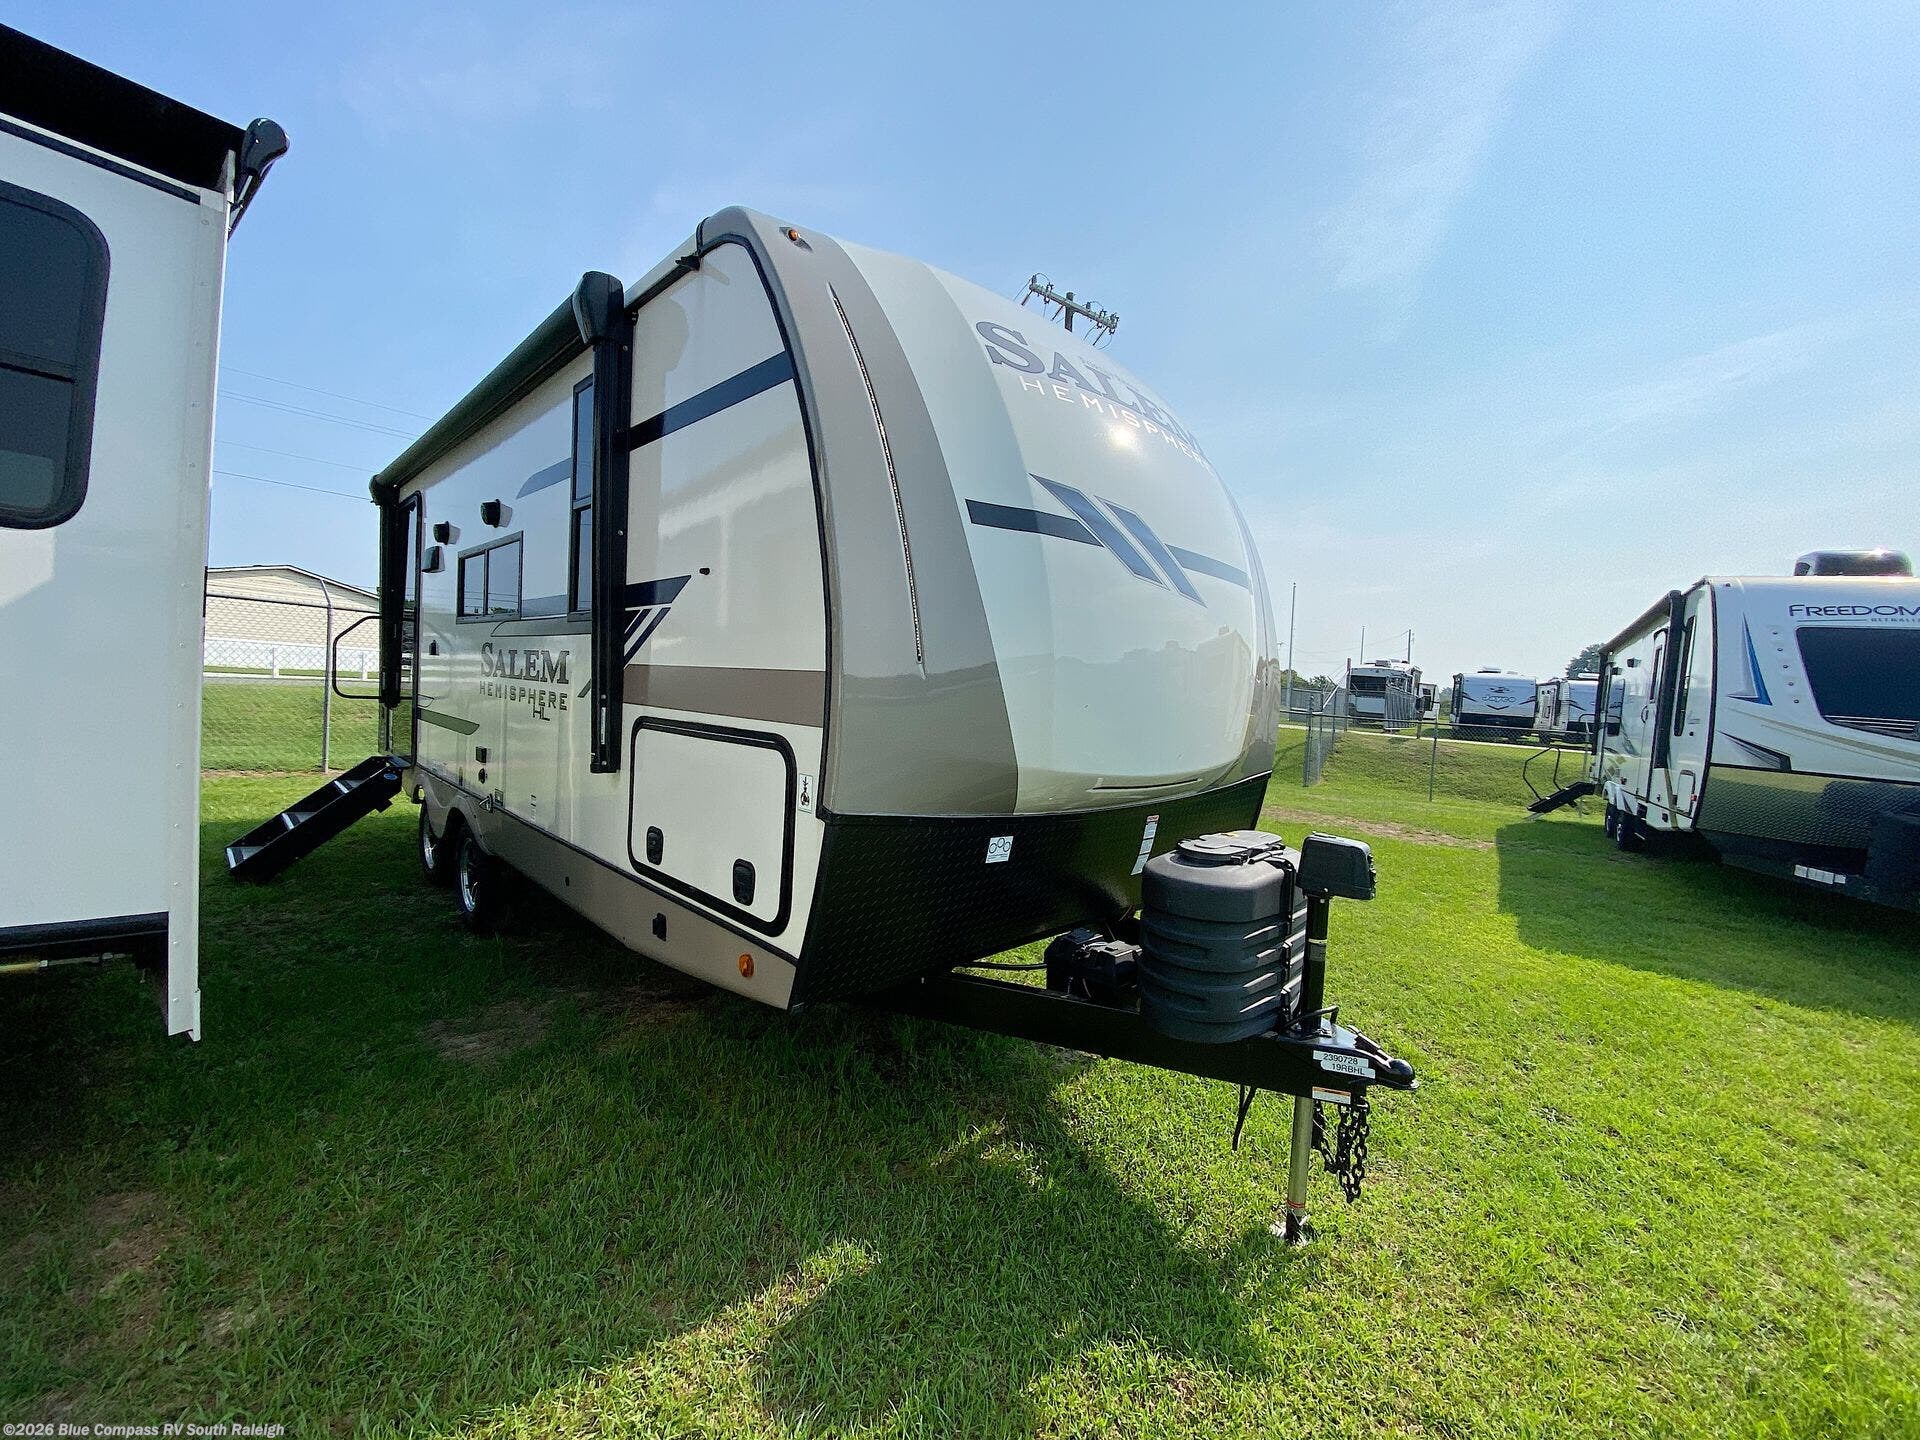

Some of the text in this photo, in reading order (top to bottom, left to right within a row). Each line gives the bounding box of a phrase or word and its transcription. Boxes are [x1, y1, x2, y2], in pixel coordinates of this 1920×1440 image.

[975, 321, 1204, 456] SALEM
[1788, 604, 1920, 617] FREEDOM
[481, 642, 569, 684] SALEM
[479, 681, 568, 710] HEMISPHERE
[532, 704, 551, 722] HL
[1332, 1063, 1365, 1075] 19RBHL
